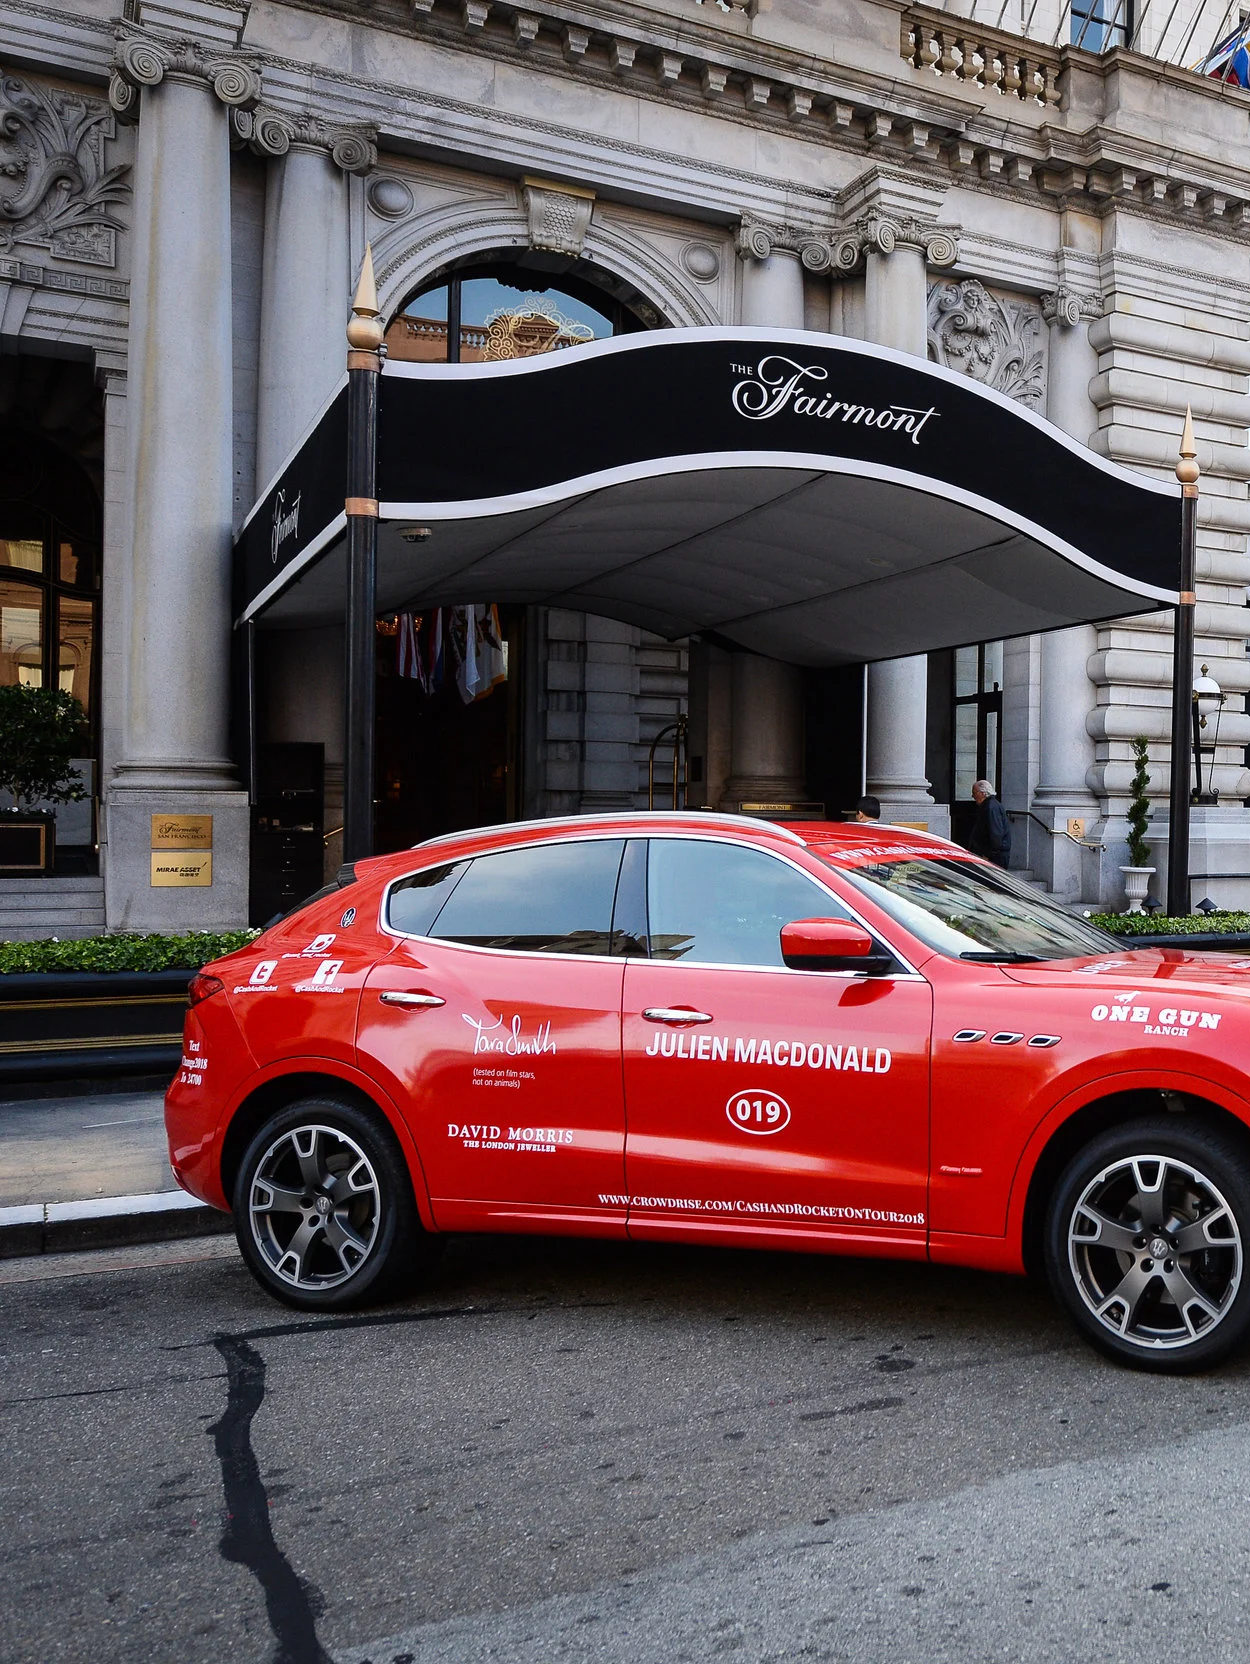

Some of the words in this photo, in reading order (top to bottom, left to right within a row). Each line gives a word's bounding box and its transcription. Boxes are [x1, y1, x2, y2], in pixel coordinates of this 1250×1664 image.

[729, 362, 753, 376] THE
[731, 355, 942, 445] Fairmont
[159, 822, 202, 834] Fairmont
[1091, 1004, 1150, 1023] ONE
[1158, 1007, 1222, 1030] GUN
[462, 1013, 505, 1055] Tara
[505, 1014, 557, 1056] Smith
[1143, 1024, 1189, 1037] RANCH
[189, 1039, 200, 1051] Text
[645, 1031, 729, 1062] JULIEN
[734, 1036, 893, 1075] MACDONALD
[180, 1071, 187, 1083] To
[473, 1067, 495, 1077] (tested
[496, 1069, 505, 1077] on
[506, 1068, 518, 1078] film
[519, 1070, 536, 1080] stars,
[472, 1078, 484, 1086] not
[494, 1079, 521, 1089] animals)
[735, 1098, 781, 1124] 019
[447, 1123, 501, 1140] DAVID
[507, 1126, 574, 1144] MORRIS
[463, 1140, 480, 1149] THE
[481, 1141, 515, 1151] LONDON
[516, 1142, 556, 1153] JEWELLER
